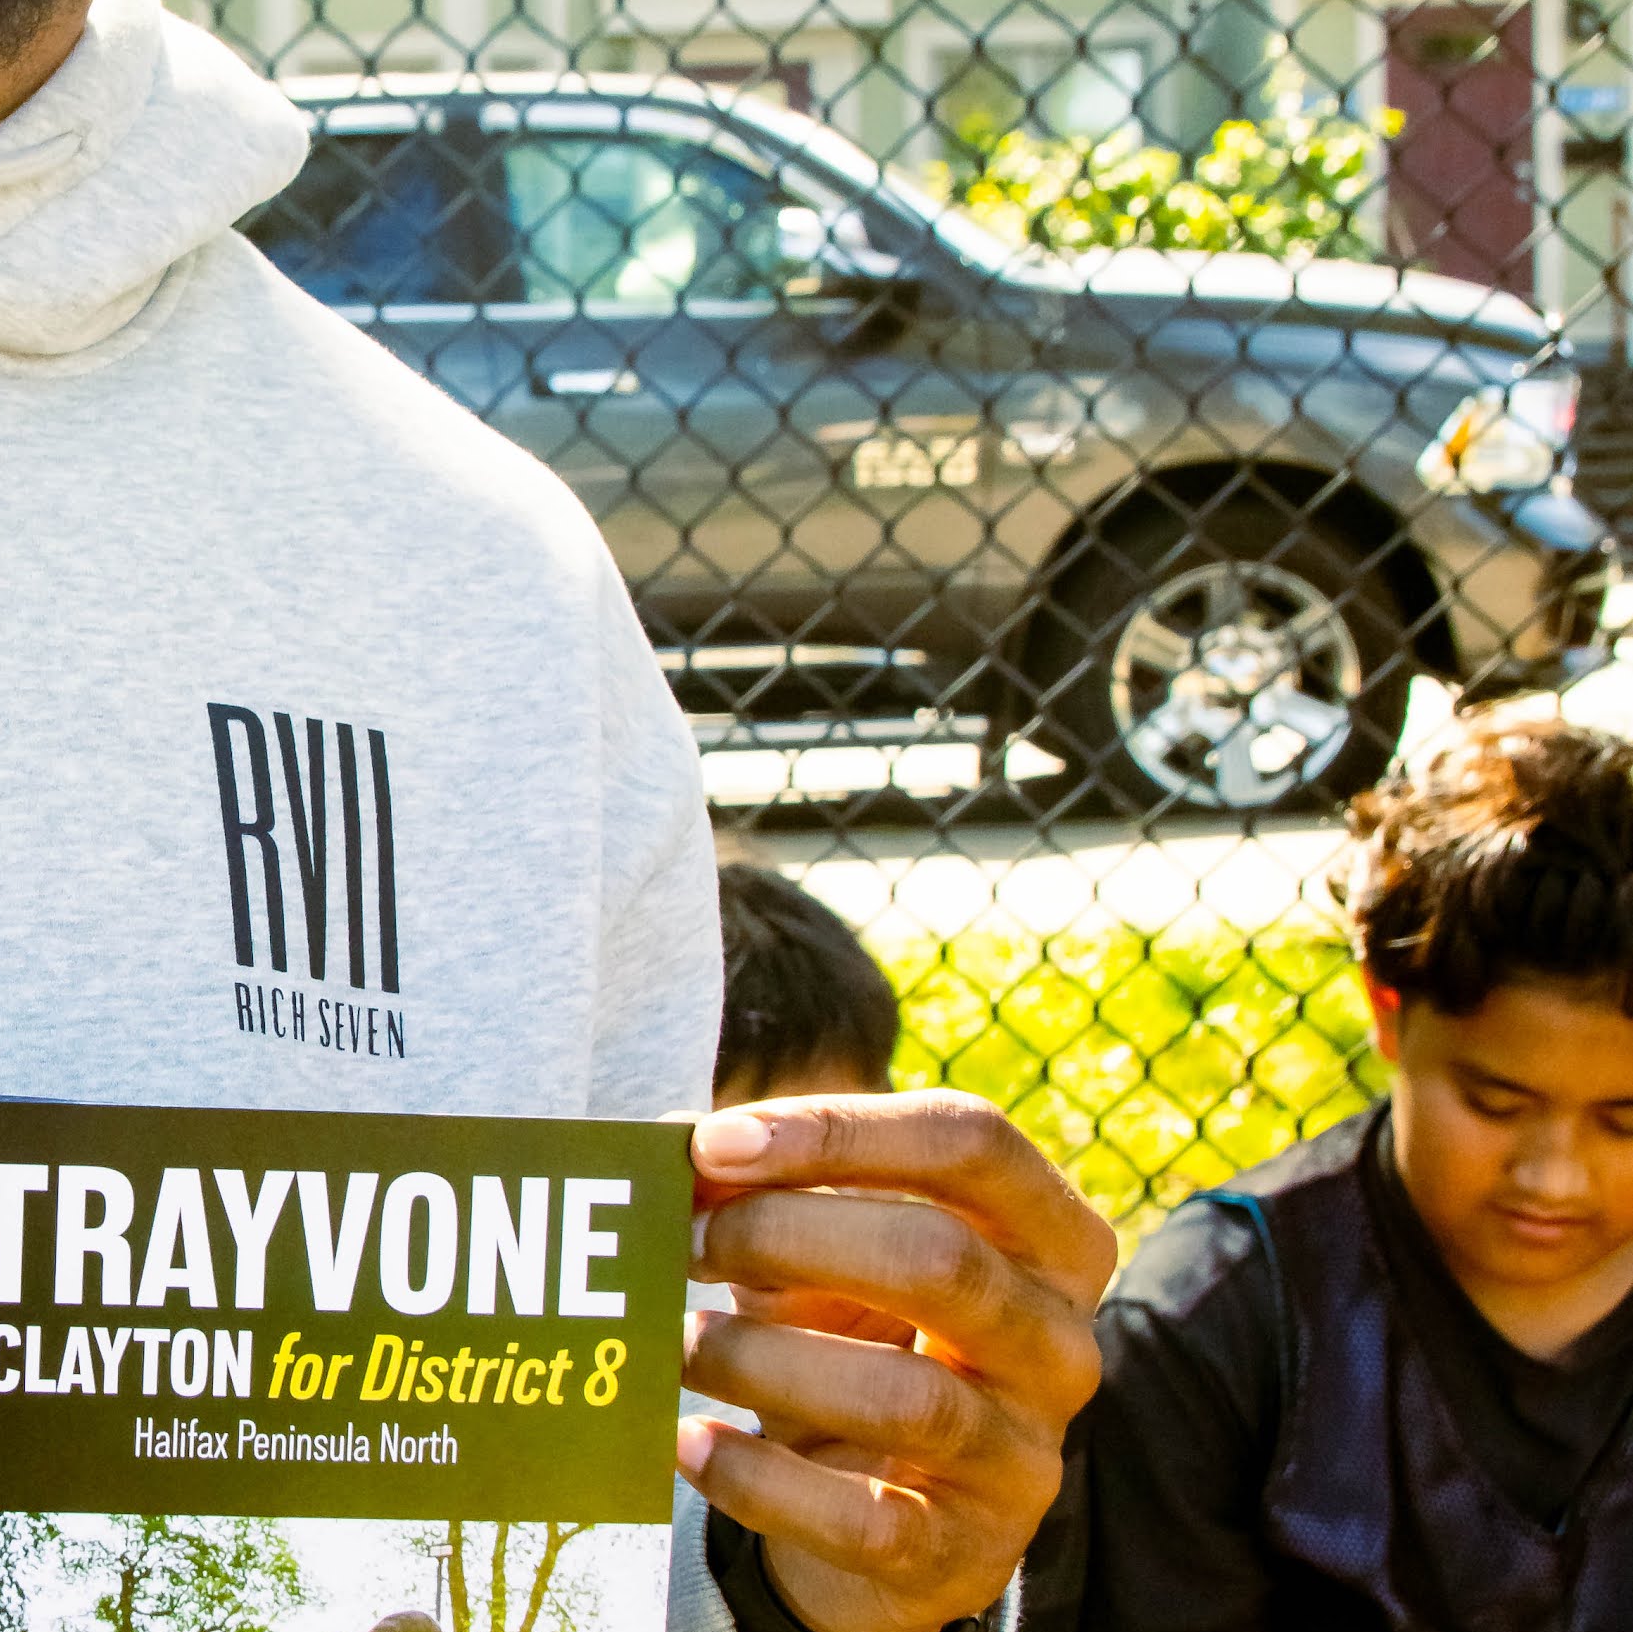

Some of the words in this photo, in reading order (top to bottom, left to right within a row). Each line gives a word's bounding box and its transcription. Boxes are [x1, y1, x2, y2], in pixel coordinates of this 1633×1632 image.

[207, 702, 400, 994] RVII
[234, 982, 306, 1042] RICH
[317, 998, 406, 1058] SEVEN
[268, 1332, 353, 1400] for
[360, 1334, 574, 1405] District
[583, 1338, 628, 1407] 8
[134, 1417, 230, 1460] Halifax
[237, 1419, 370, 1463] Peninsula
[380, 1422, 458, 1465] North
